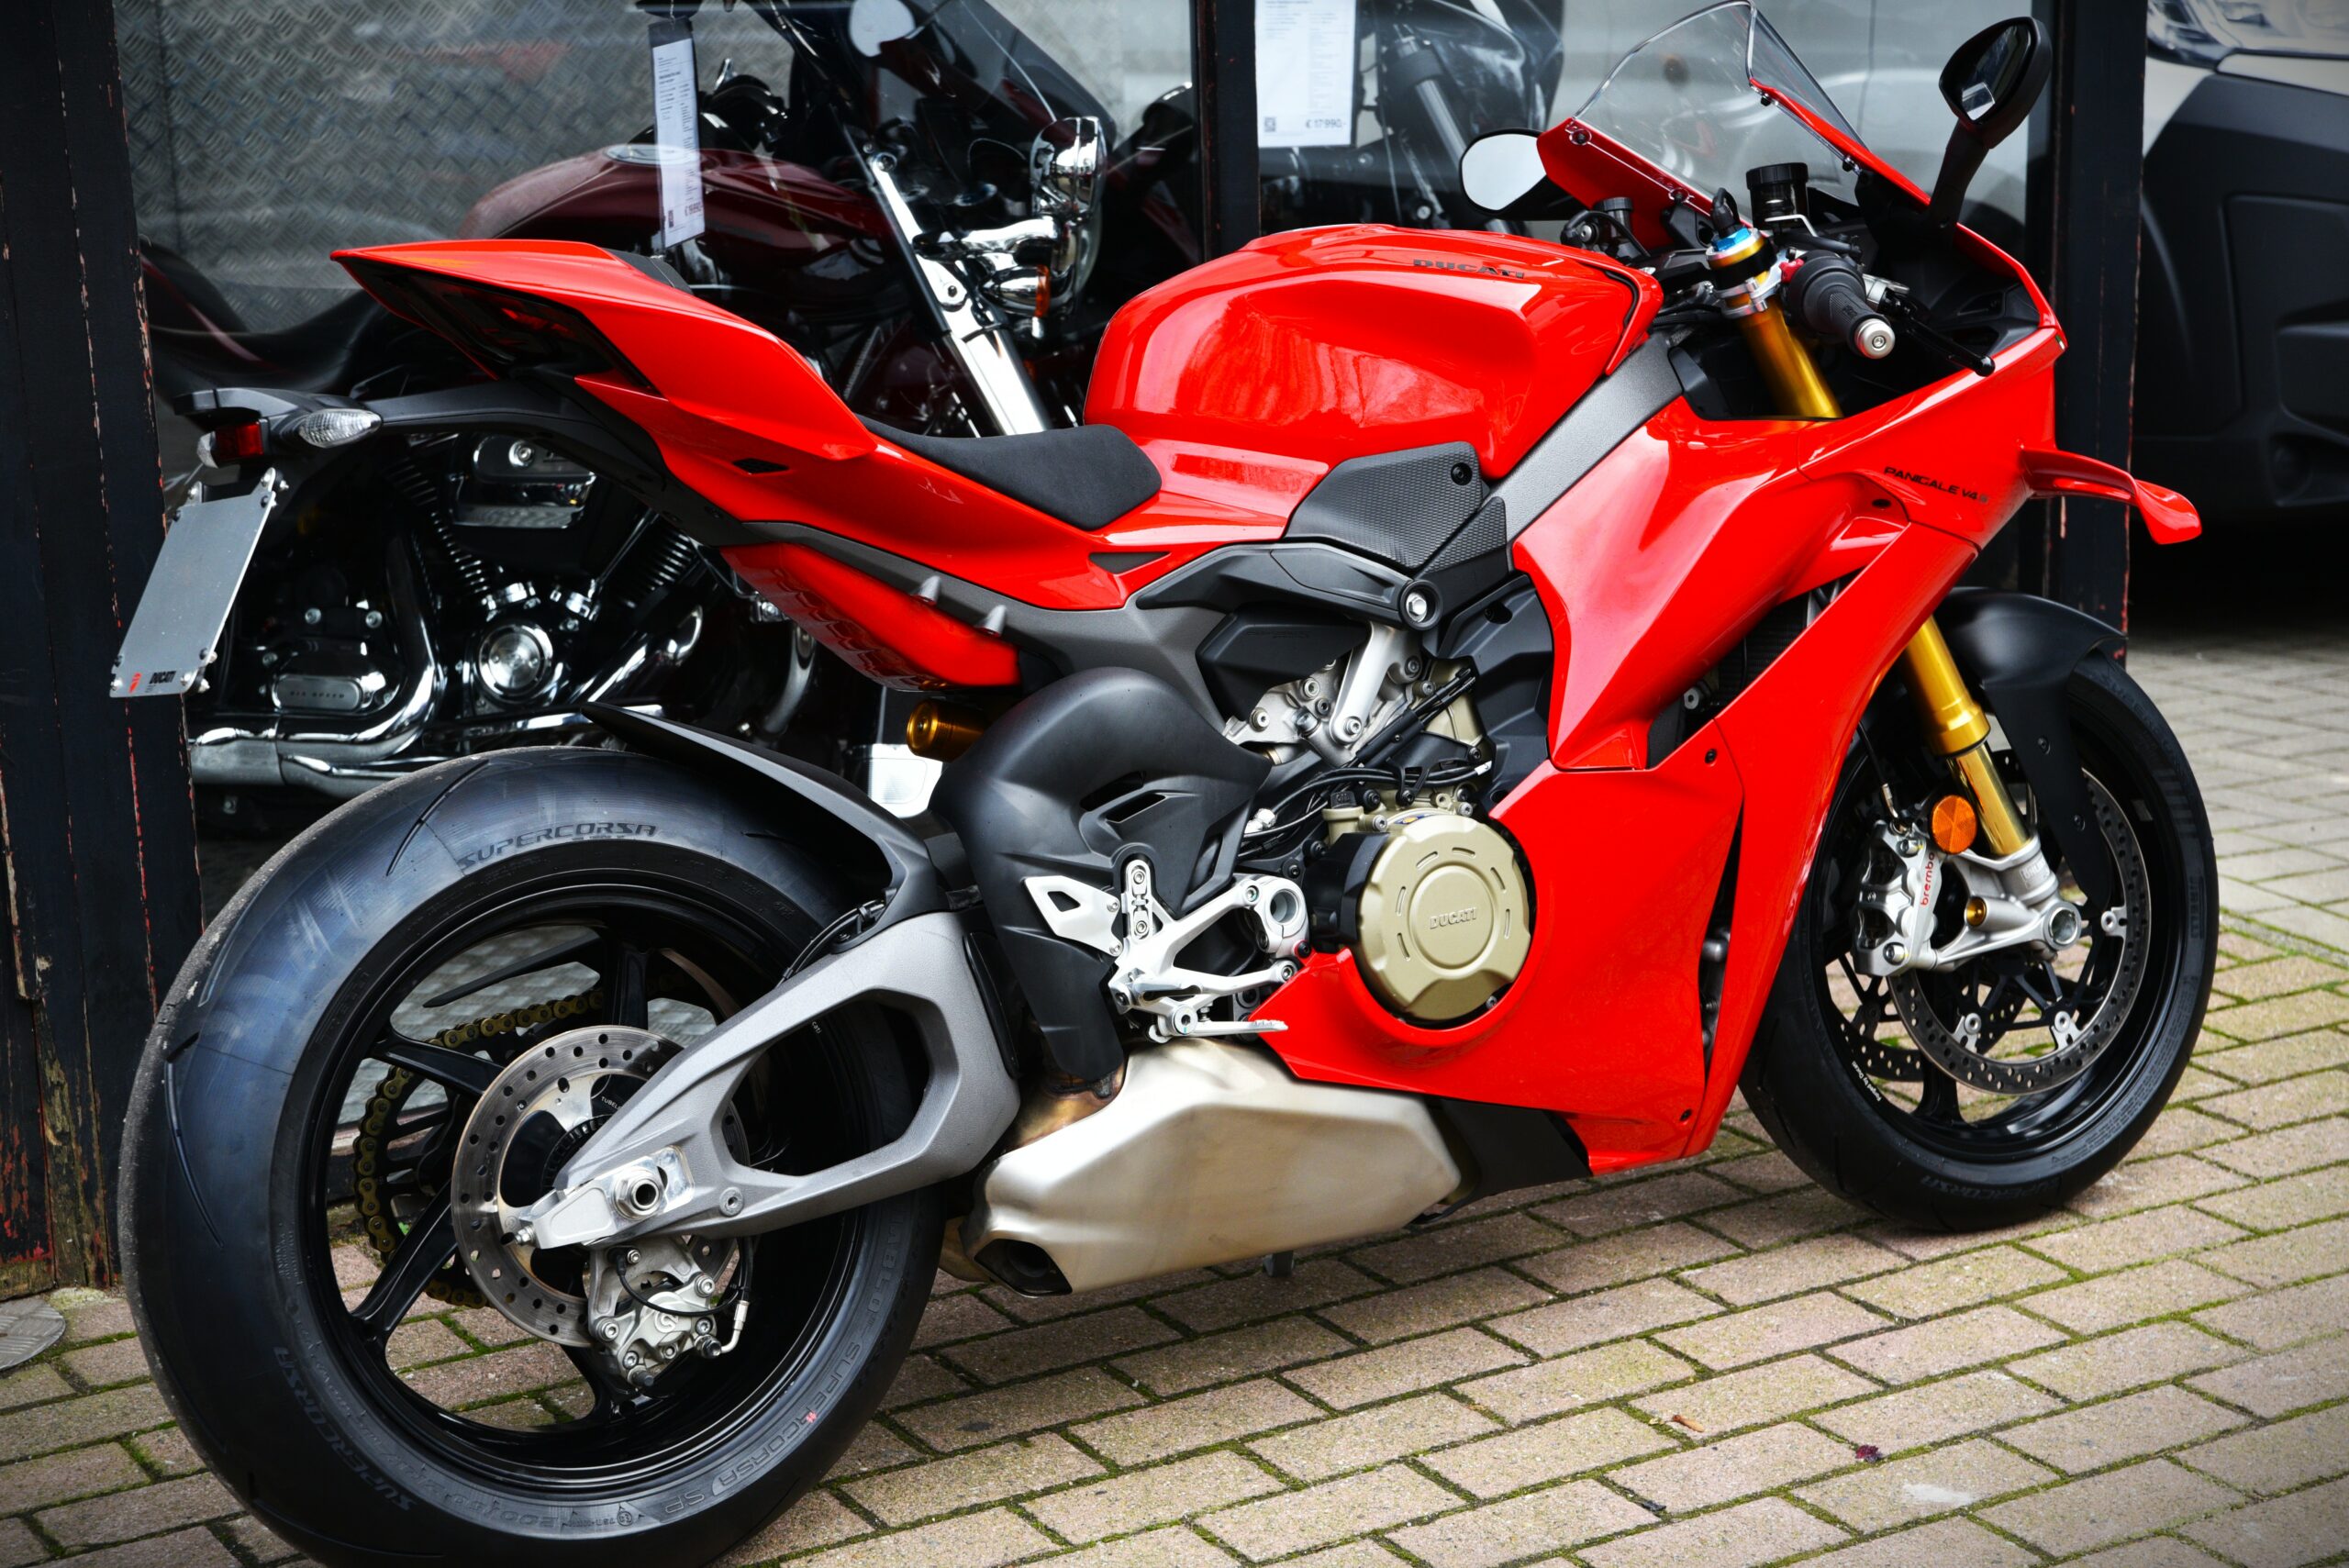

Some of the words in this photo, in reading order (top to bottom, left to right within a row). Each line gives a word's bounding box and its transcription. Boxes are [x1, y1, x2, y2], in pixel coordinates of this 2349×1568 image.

[1414, 259, 1524, 279] DUCATI
[1884, 466, 1960, 495] PANIGALE
[1962, 488, 1978, 500] V4
[457, 822, 656, 871] SUPERCORSA
[1920, 851, 1935, 906] brembo
[1430, 907, 1476, 929] DUCATI
[274, 1347, 417, 1510] SUPERCORSA
